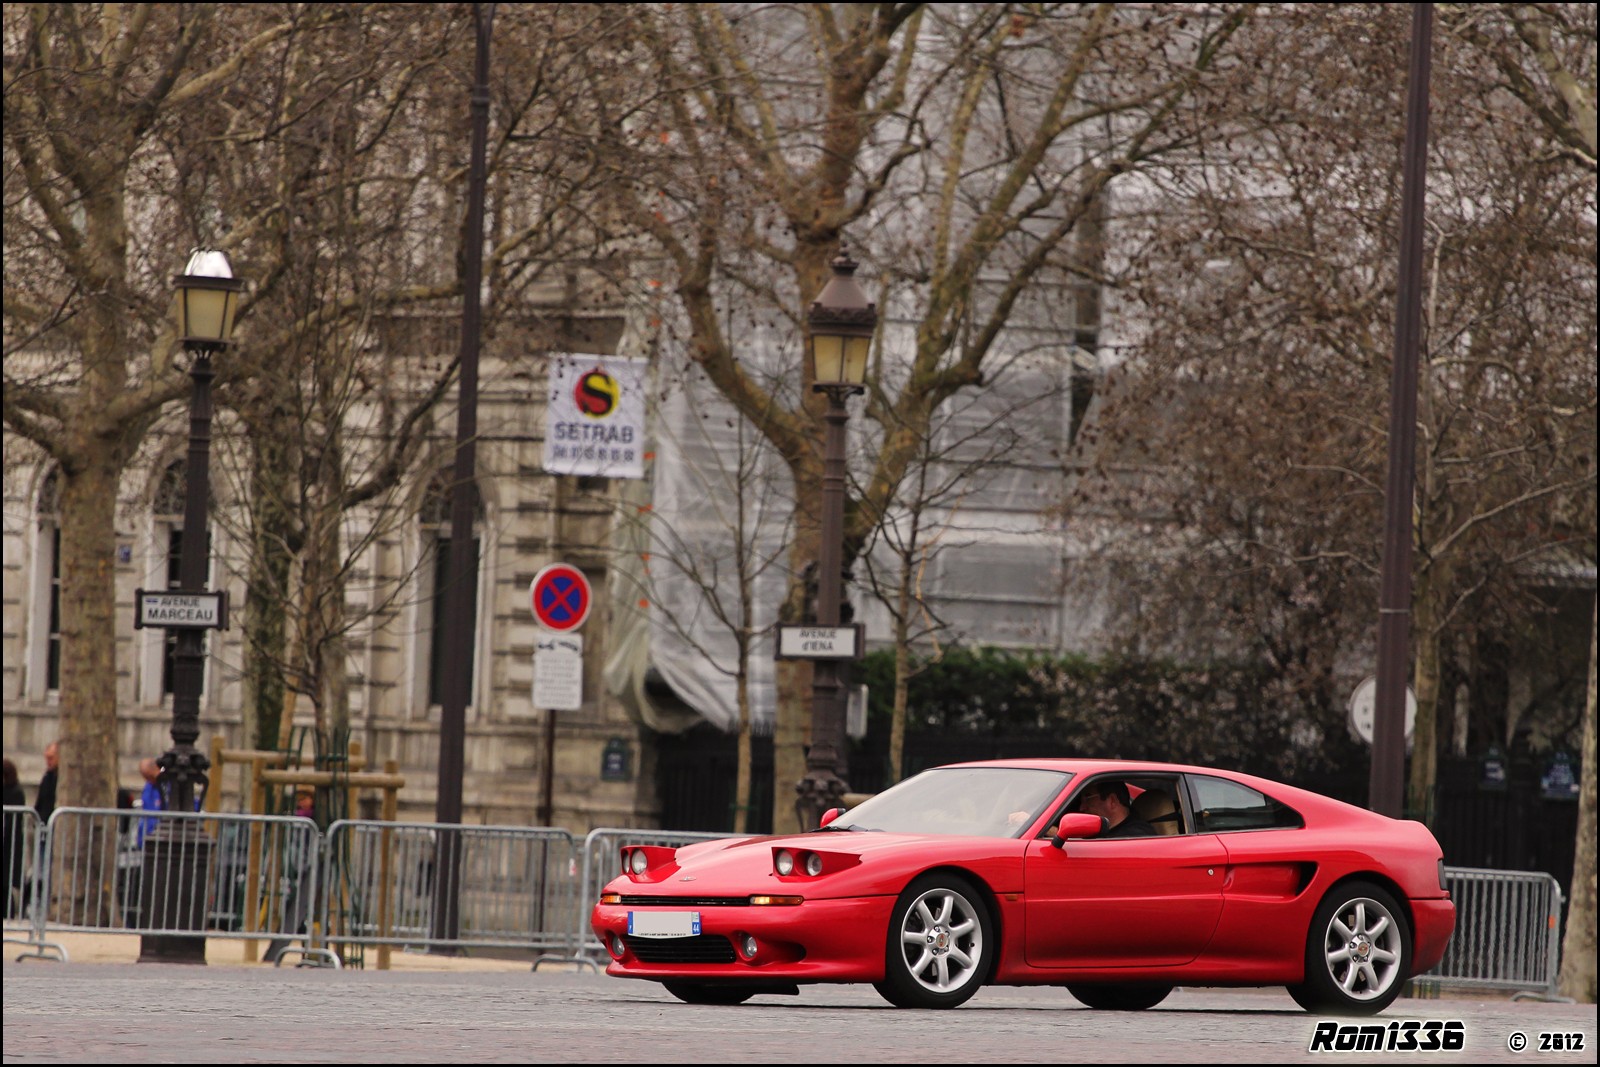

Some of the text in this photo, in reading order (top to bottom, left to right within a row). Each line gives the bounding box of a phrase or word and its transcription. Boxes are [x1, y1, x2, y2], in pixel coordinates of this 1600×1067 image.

[554, 421, 635, 444] SETRAB
[160, 597, 200, 607] AVENUE
[147, 608, 213, 621] MARCEAU
